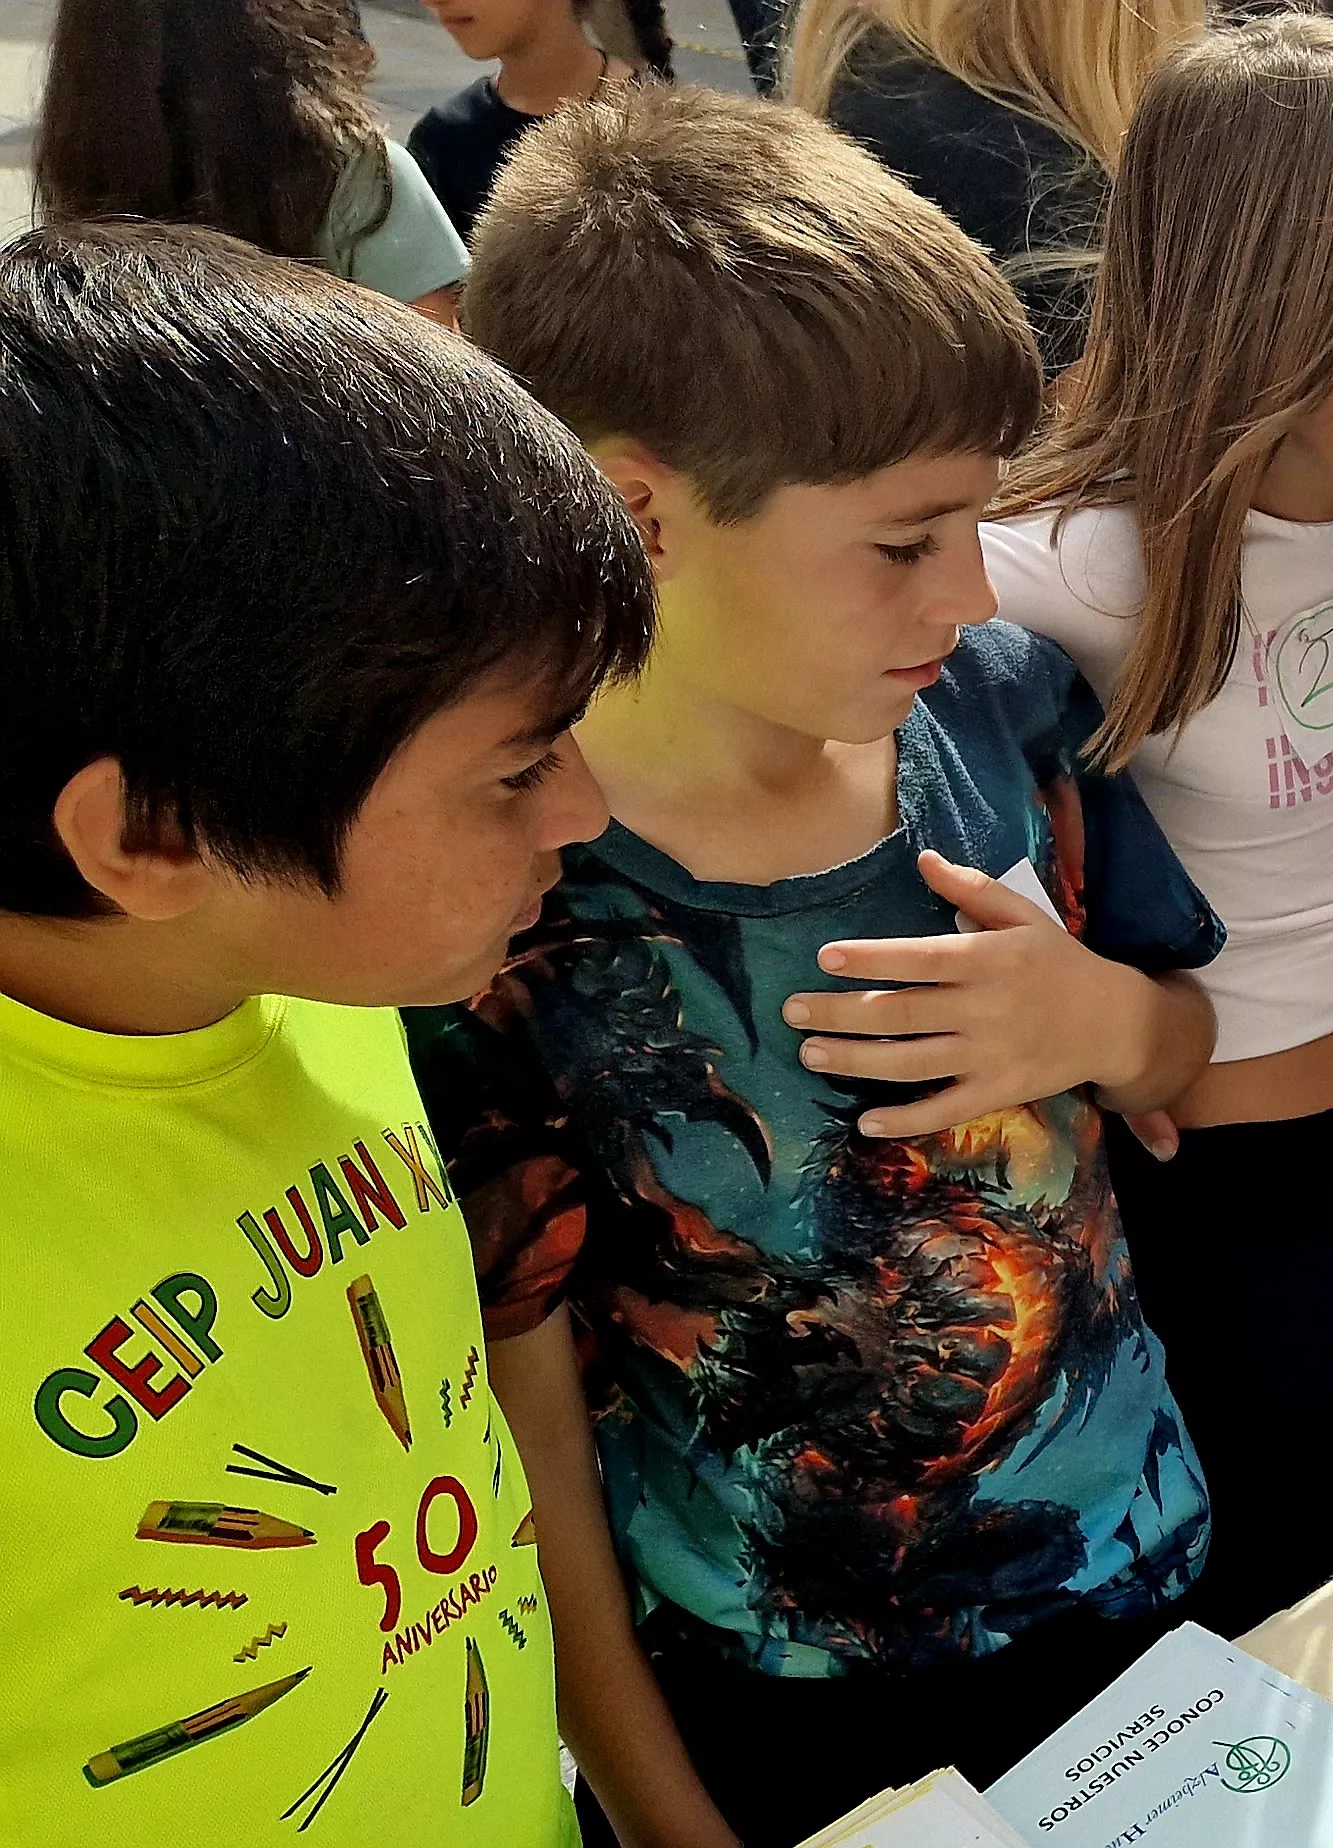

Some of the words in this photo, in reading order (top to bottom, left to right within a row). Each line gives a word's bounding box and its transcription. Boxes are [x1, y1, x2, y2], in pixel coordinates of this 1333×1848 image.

[33, 1271, 224, 1460] CEIP
[236, 1137, 408, 1321] JUAN
[354, 1475, 480, 1633] 50
[381, 1565, 498, 1675] ANIVERSARIO
[1064, 1704, 1166, 1782] SERVICIOS
[1142, 1688, 1225, 1752] CONOCE
[1037, 1749, 1145, 1832] NUESTROS
[1145, 1761, 1221, 1826] Alzheimer
